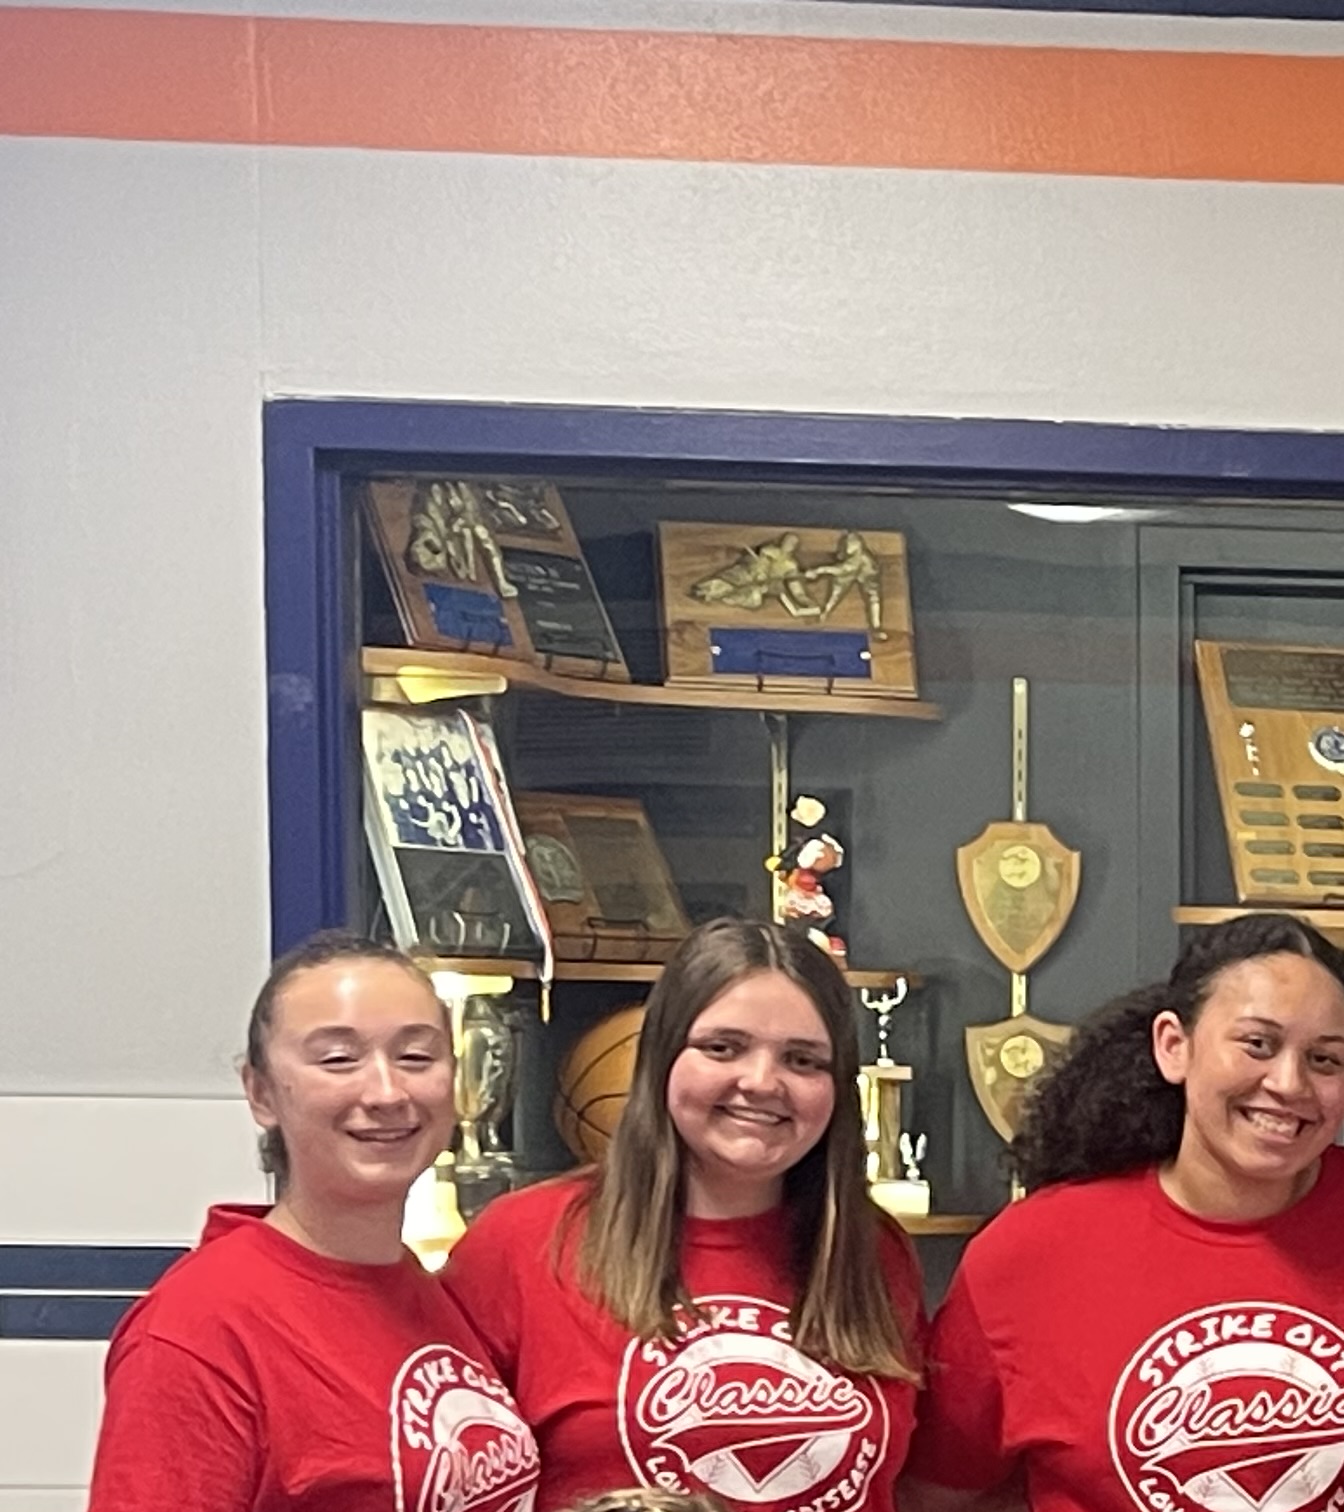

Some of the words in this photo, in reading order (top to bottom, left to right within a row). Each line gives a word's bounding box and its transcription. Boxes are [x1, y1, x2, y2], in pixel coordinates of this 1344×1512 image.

[1138, 1313, 1277, 1387] STRIKE
[403, 1356, 460, 1451] STRIKE
[636, 1366, 854, 1434] Classic
[646, 1456, 691, 1495] LOU
